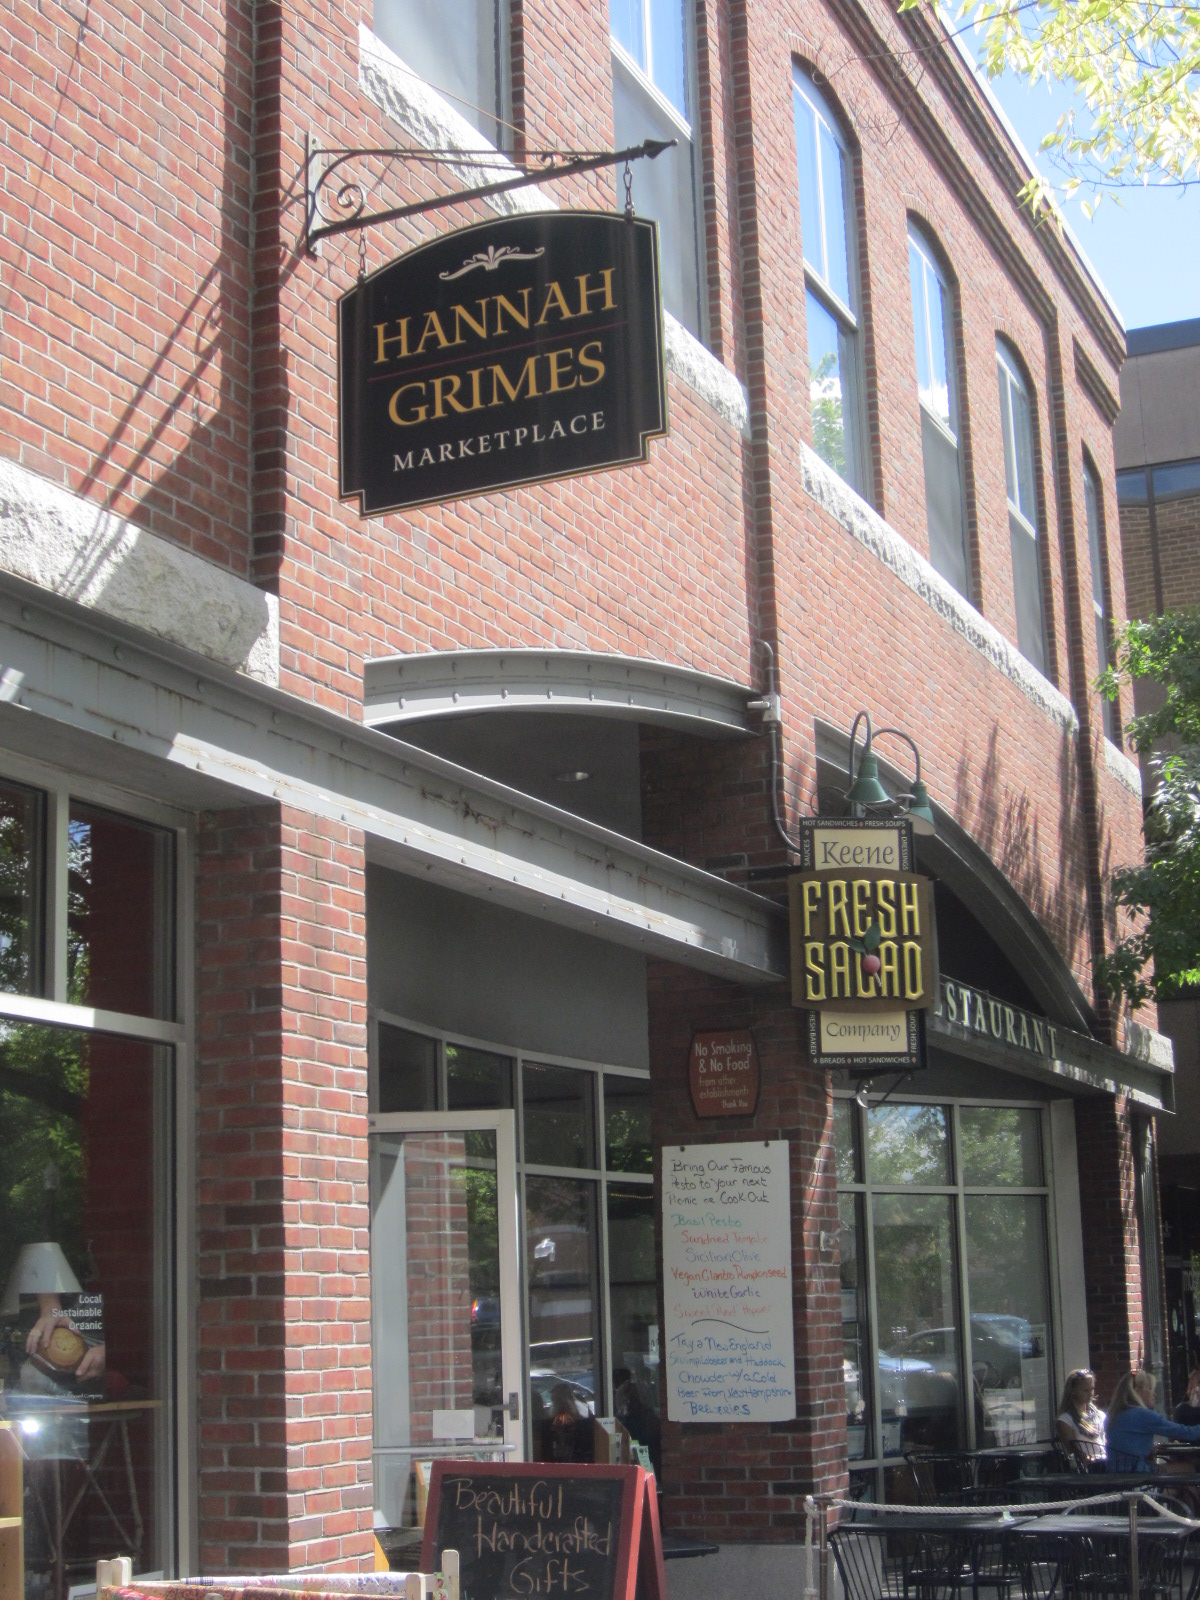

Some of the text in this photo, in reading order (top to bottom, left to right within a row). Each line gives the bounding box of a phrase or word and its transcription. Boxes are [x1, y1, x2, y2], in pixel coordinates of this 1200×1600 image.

[373, 267, 618, 364] HANNAH
[388, 341, 606, 426] GRIMES
[392, 411, 606, 472] MARKETPLACE
[803, 839, 811, 866] SAUCES
[820, 841, 895, 866] Keene
[802, 879, 921, 938] FRESH
[805, 941, 925, 1001] SALAD
[826, 1022, 901, 1042] Company
[934, 981, 1057, 1060] STAURANT
[695, 1038, 752, 1057] No Smoking
[868, 1056, 910, 1064] SANDWICHES
[698, 1056, 750, 1073] & No Food
[671, 1158, 772, 1177] Bring Our Famous
[699, 1178, 711, 1189] to
[711, 1178, 737, 1192] your
[742, 1176, 767, 1187] next
[78, 1294, 102, 1304] Local
[51, 1308, 102, 1317] Sustainable
[68, 1321, 102, 1331] Organic
[443, 1478, 563, 1519] Beautiful
[473, 1515, 612, 1558] Handcrafted
[510, 1556, 590, 1594] Gifts
